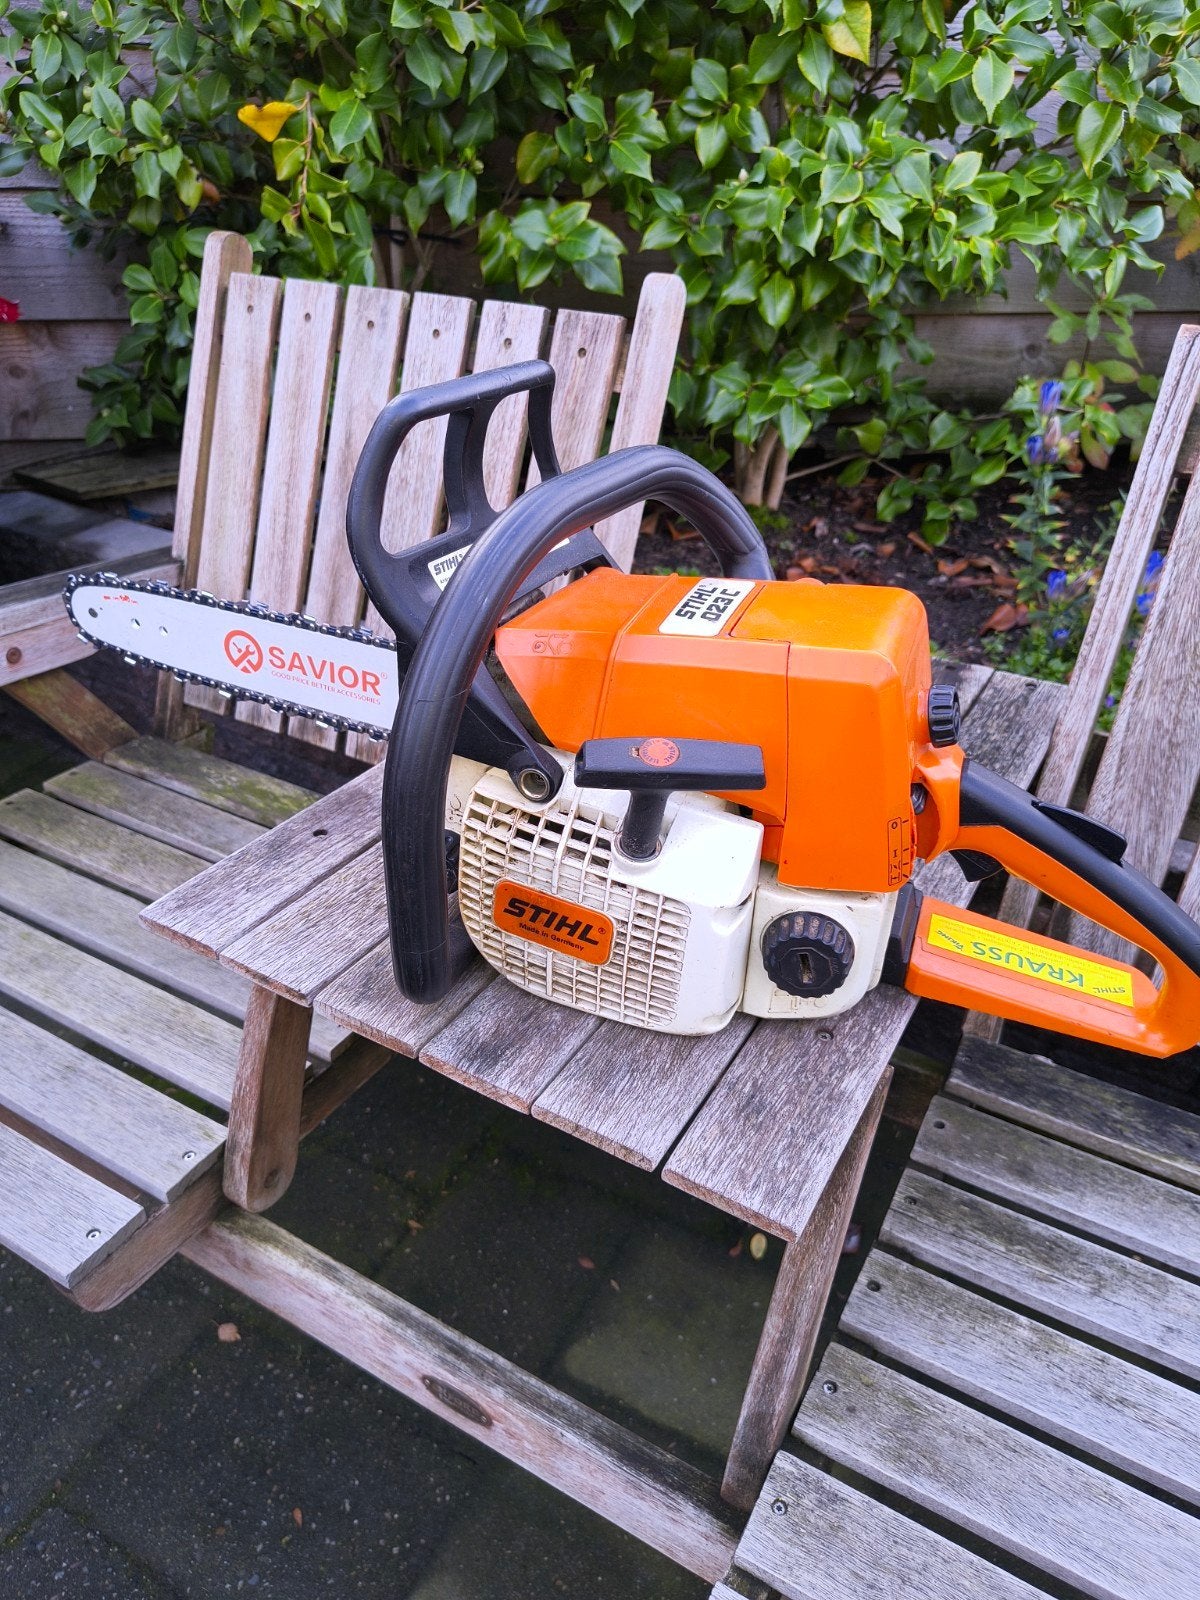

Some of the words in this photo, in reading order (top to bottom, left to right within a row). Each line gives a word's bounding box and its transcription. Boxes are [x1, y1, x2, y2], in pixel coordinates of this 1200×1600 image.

[675, 587, 718, 620] STIHL
[268, 646, 381, 697] SAVIOR
[271, 670, 291, 681] GOOD
[292, 675, 310, 686] PRICE
[311, 681, 336, 693] BETTER
[503, 897, 600, 946] STIHL
[519, 922, 540, 935] Made
[550, 934, 585, 952] Germany
[936, 930, 964, 952] VIKING
[970, 941, 1084, 988] KRAUSS
[1092, 986, 1126, 994] STIHL
